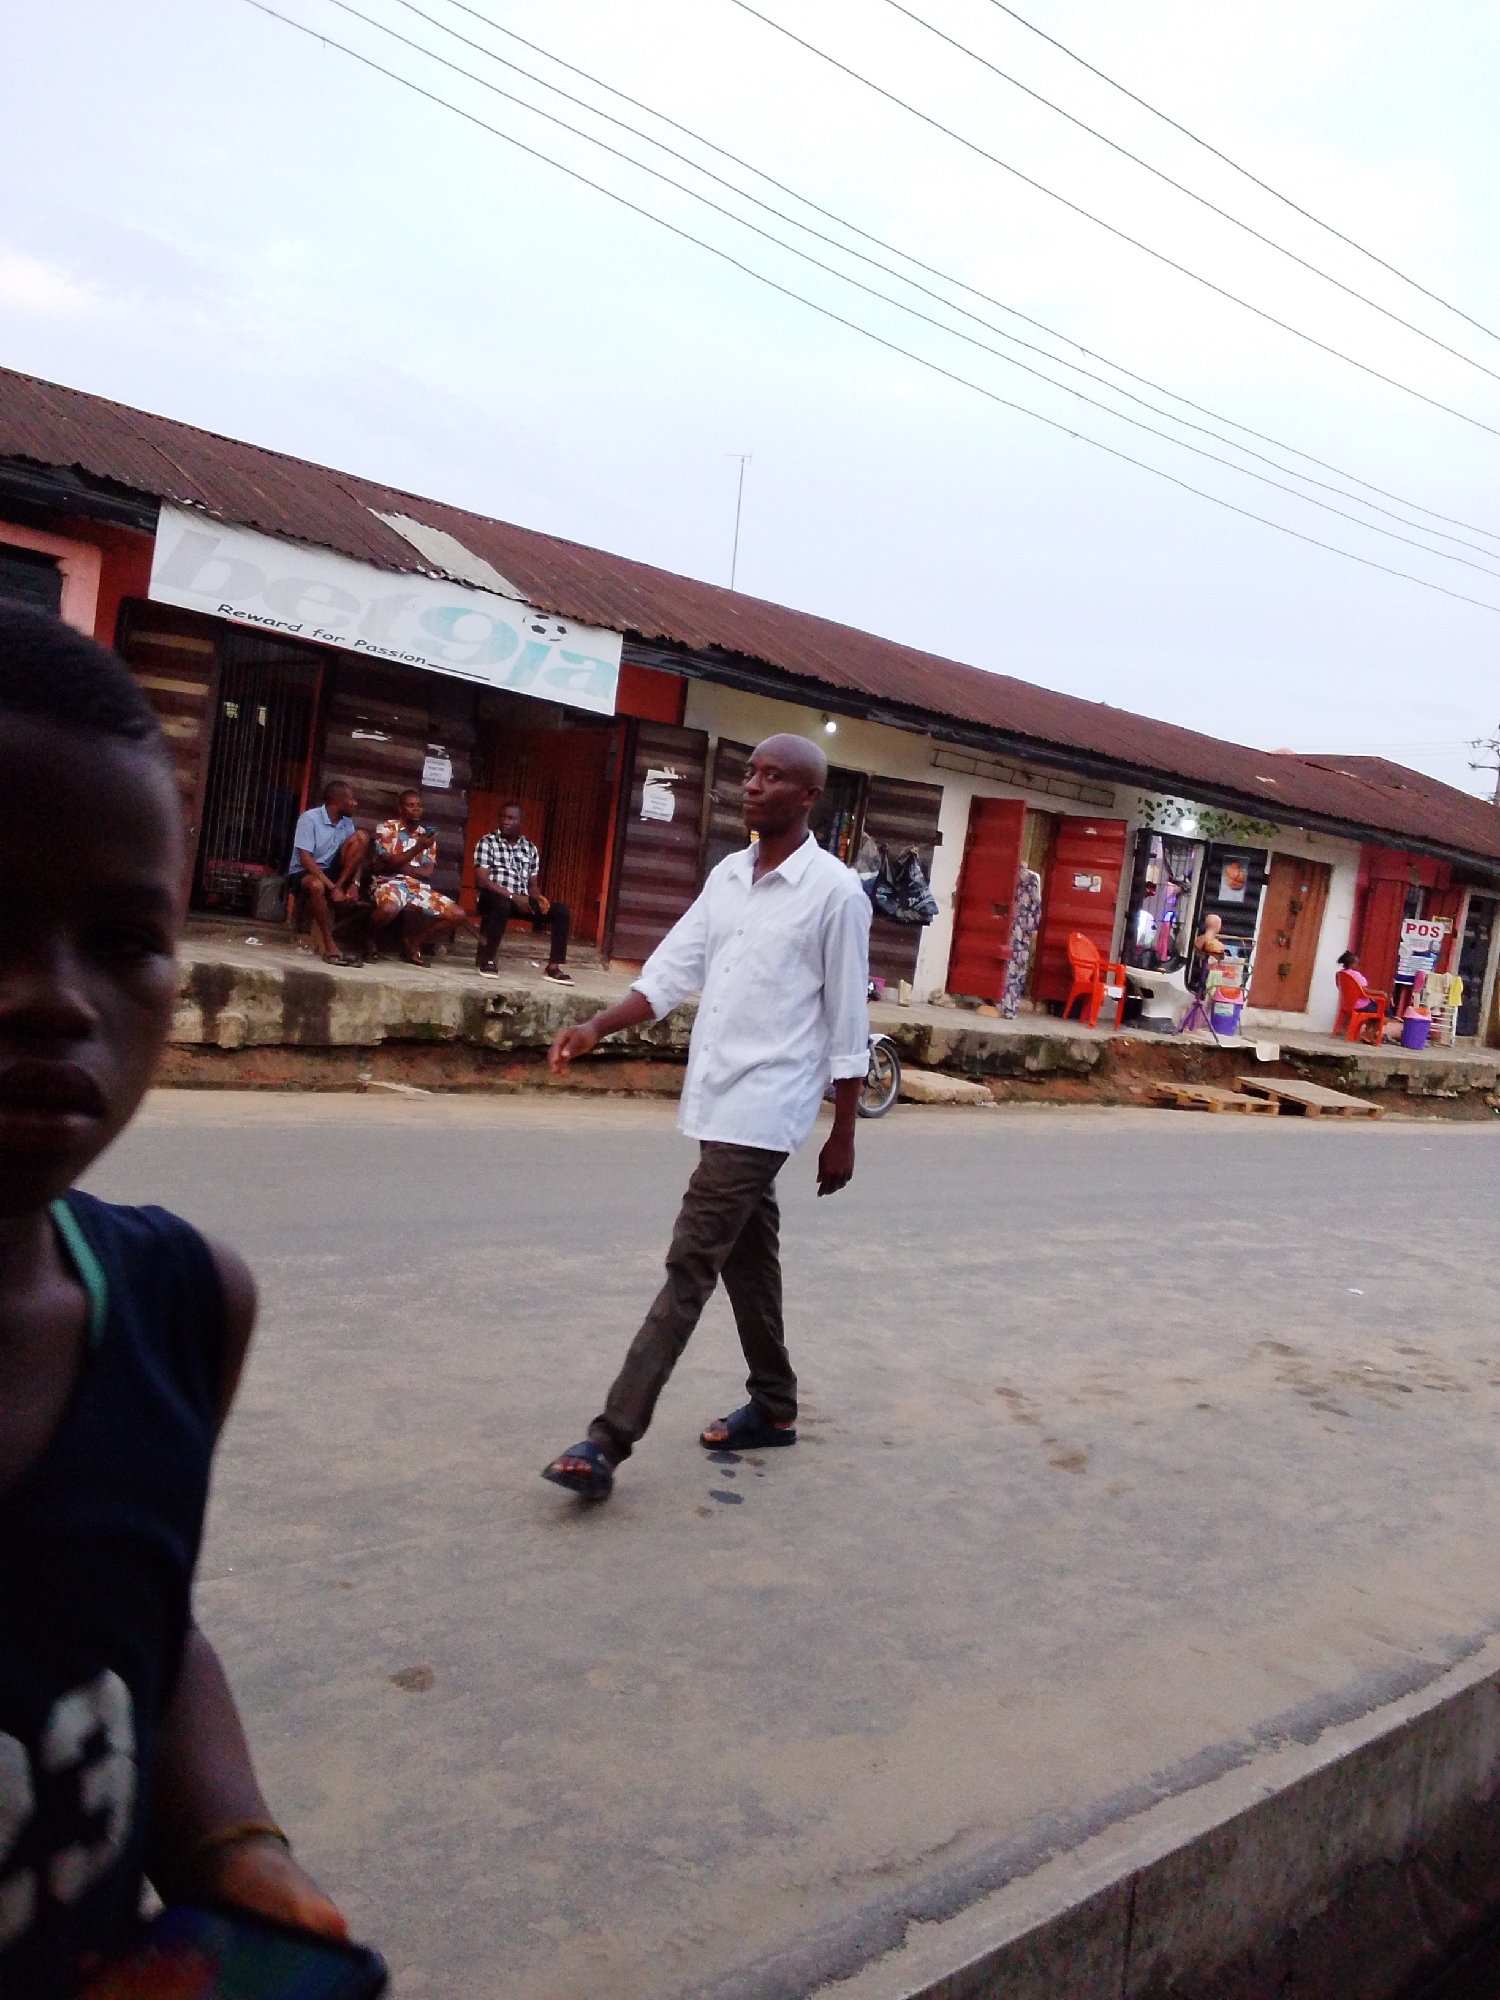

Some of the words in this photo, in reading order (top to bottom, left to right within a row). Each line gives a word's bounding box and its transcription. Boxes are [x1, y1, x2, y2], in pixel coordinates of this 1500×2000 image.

[152, 529, 618, 699] bet9ja
[217, 604, 303, 633] Reward
[312, 628, 346, 644] for
[354, 639, 426, 665] Passion
[1406, 922, 1440, 938] POS
